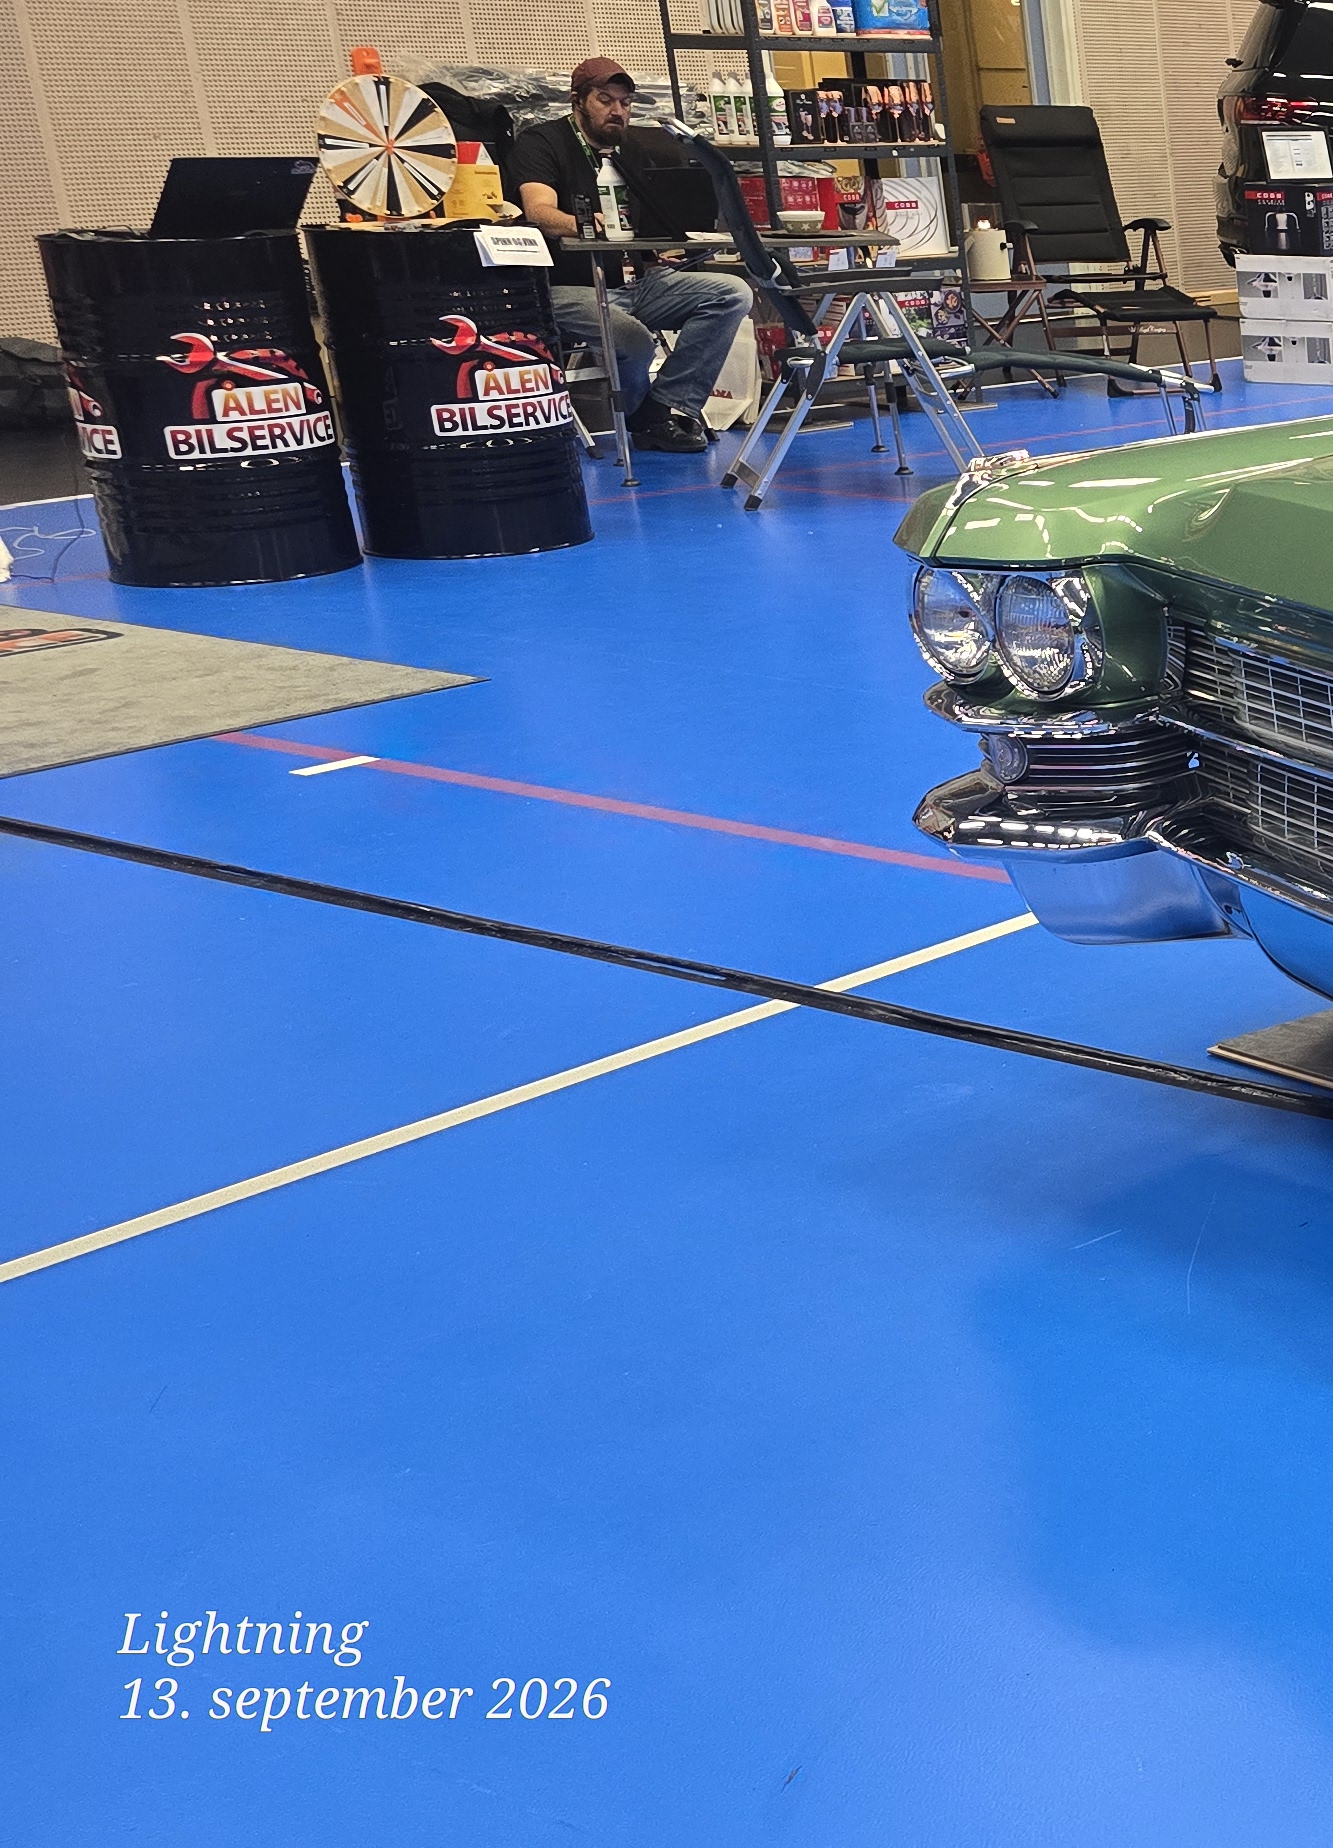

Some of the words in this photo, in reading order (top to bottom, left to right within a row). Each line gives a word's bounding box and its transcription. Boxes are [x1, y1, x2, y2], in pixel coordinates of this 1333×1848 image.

[483, 361, 550, 397] ÅLEN
[221, 380, 303, 418] ÅLEN
[435, 394, 573, 433] BILSERVICE
[79, 426, 117, 456] ICE
[169, 414, 333, 456] BILSERVICE
